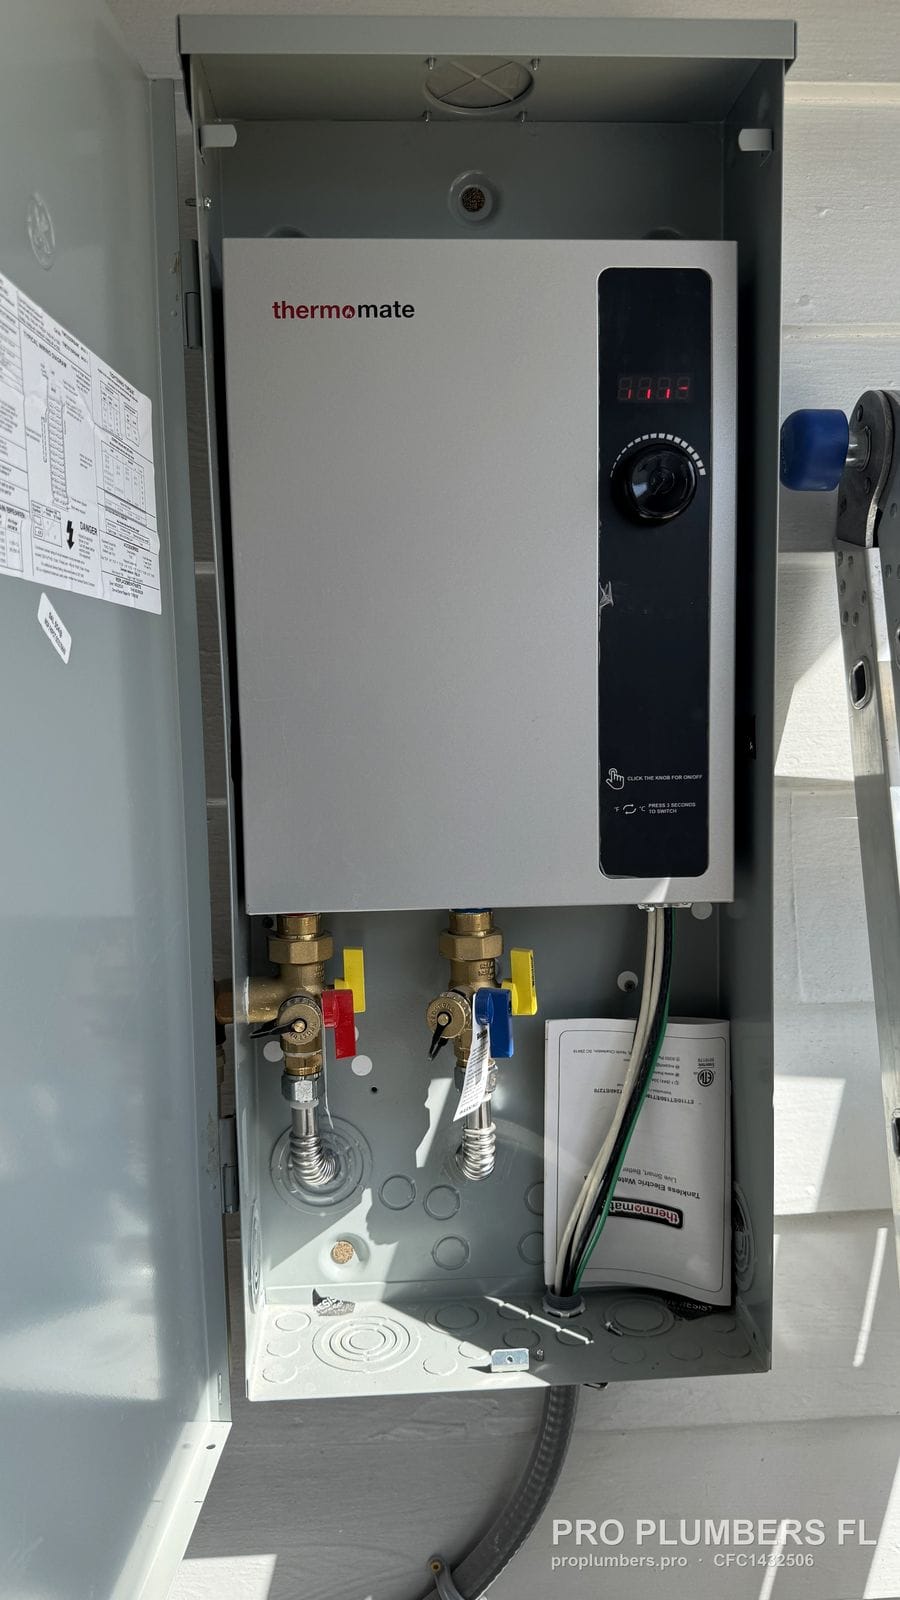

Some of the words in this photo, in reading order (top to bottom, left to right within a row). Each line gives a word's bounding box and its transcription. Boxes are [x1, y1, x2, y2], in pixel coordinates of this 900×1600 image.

[272, 301, 415, 319] thermomate
[79, 521, 98, 536] DANGER
[617, 1176, 636, 1185] Wate
[638, 1179, 666, 1191] Electric
[664, 1174, 677, 1183] Live
[667, 1185, 701, 1199] Tankless
[608, 1200, 680, 1224] thermomat
